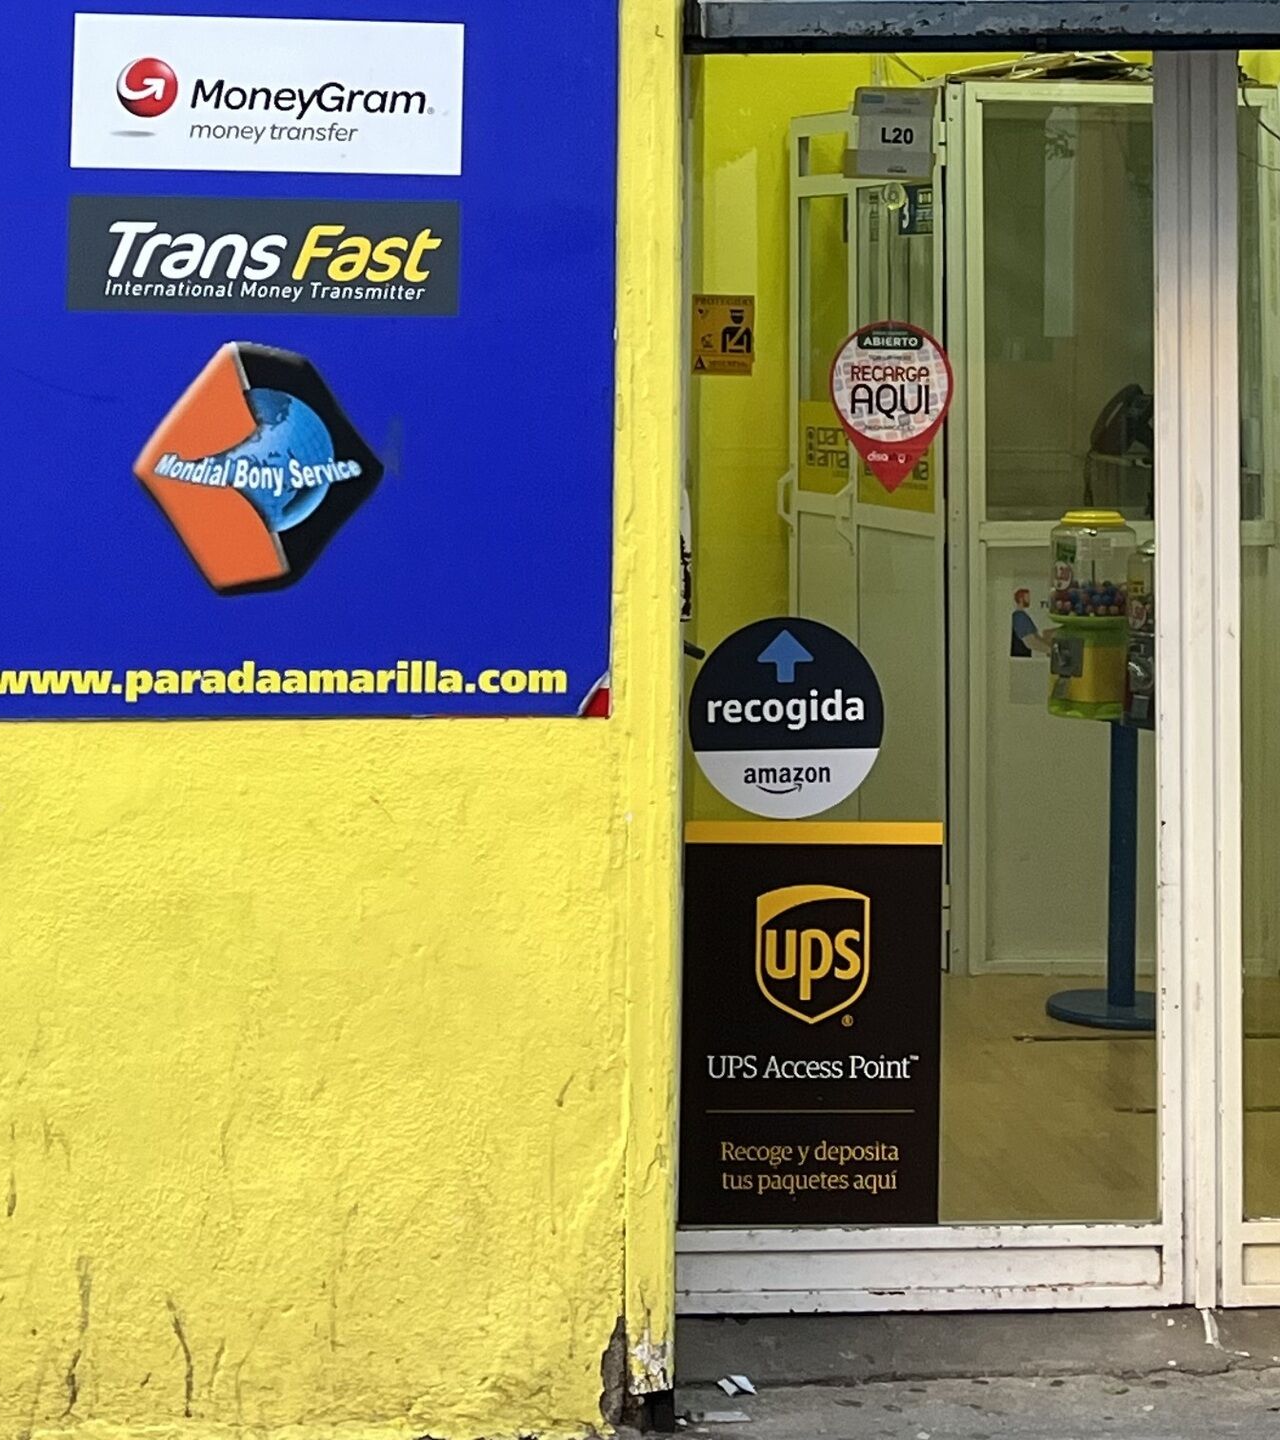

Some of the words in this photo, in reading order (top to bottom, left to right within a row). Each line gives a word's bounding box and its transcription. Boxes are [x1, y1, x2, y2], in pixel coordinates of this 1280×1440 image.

[190, 78, 427, 120] MoneyGram
[189, 123, 267, 144] money
[270, 123, 358, 142] transfer
[881, 127, 914, 145] L20
[107, 220, 288, 280] Trans
[291, 224, 443, 283] Fast
[105, 279, 233, 298] International
[240, 282, 303, 303] Money
[310, 282, 425, 301] Transmitter
[863, 337, 919, 346] ABIERTO
[850, 366, 929, 382] RECARGA
[850, 384, 930, 420] AQUI
[154, 453, 229, 488] Mondial
[232, 459, 284, 497] Bony
[288, 457, 363, 489] Service
[707, 689, 865, 730] recogida
[744, 766, 831, 784] amazon
[766, 929, 861, 1000] ups
[707, 1056, 757, 1079] UPS
[764, 1055, 843, 1079] Access
[721, 1141, 793, 1165] Recoge
[798, 1148, 809, 1165] y
[814, 1142, 899, 1166] deposita
[722, 1172, 753, 1190] tus
[757, 1173, 849, 1194] paquetes
[853, 1170, 897, 1194] aquí
